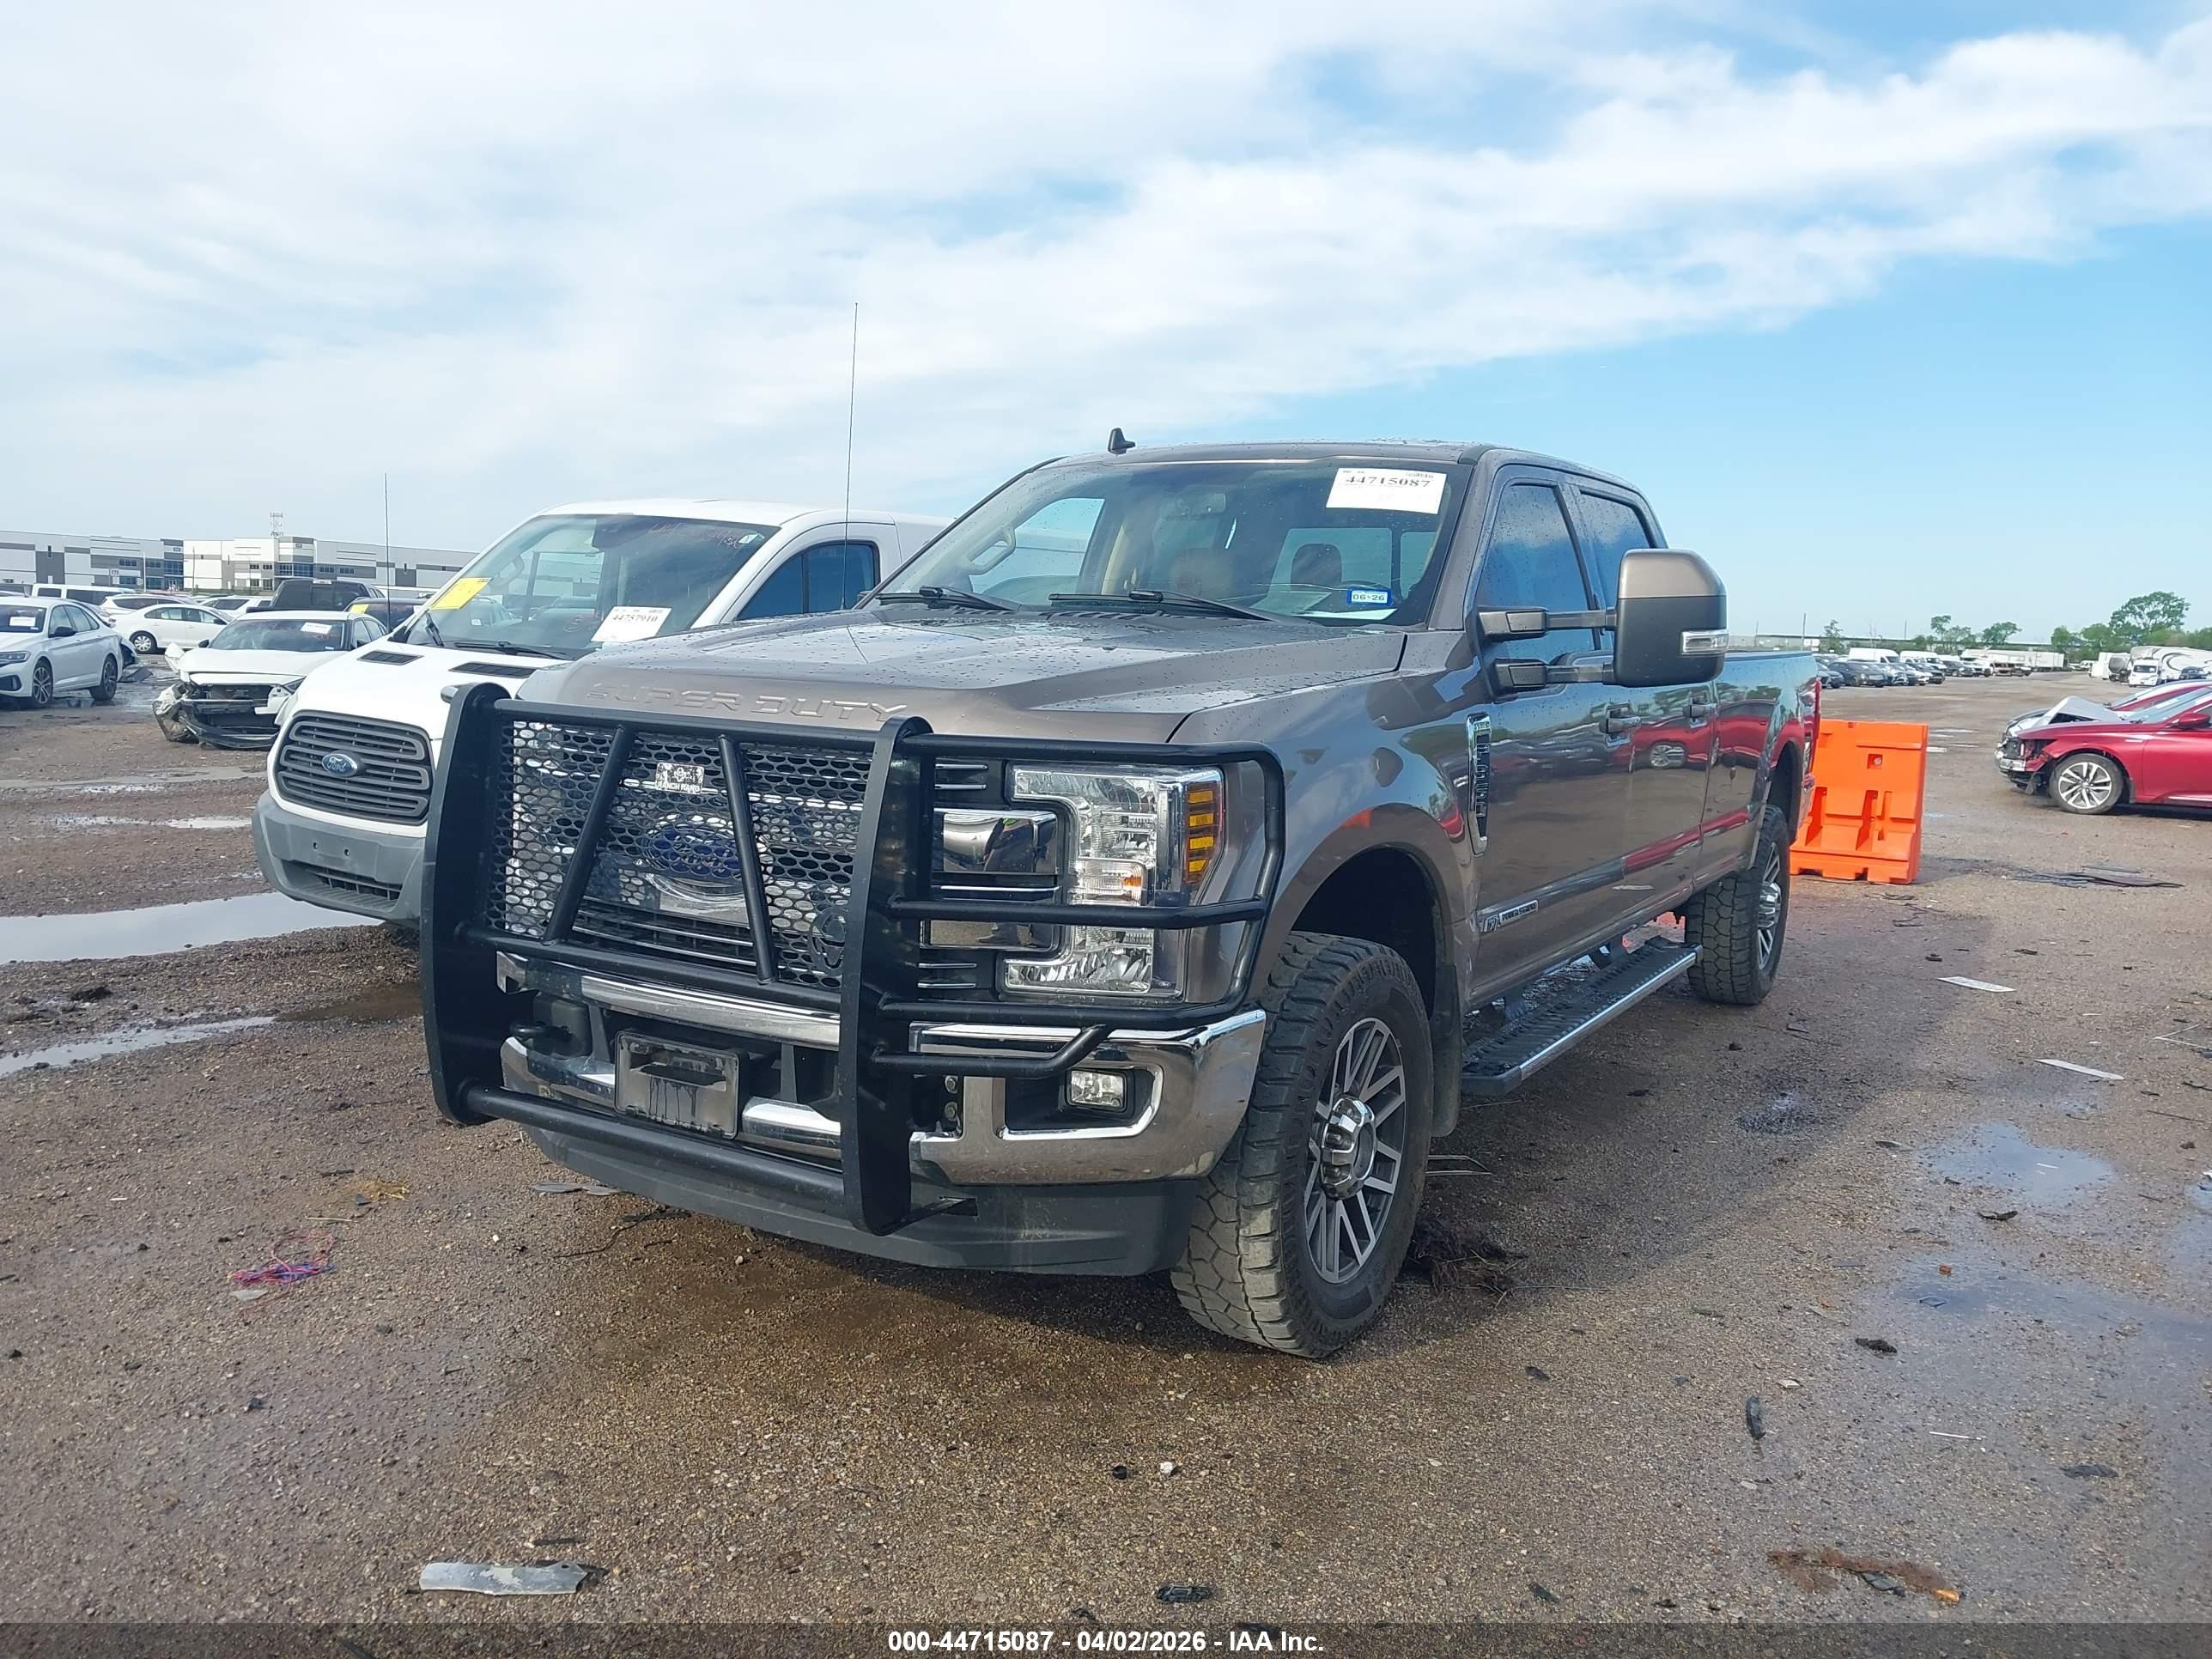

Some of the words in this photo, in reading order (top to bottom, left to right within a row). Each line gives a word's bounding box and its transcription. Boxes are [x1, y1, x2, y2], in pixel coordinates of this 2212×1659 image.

[1346, 476, 1431, 488] 44715087
[586, 683, 743, 712] SUPER
[750, 695, 908, 722] DUTY
